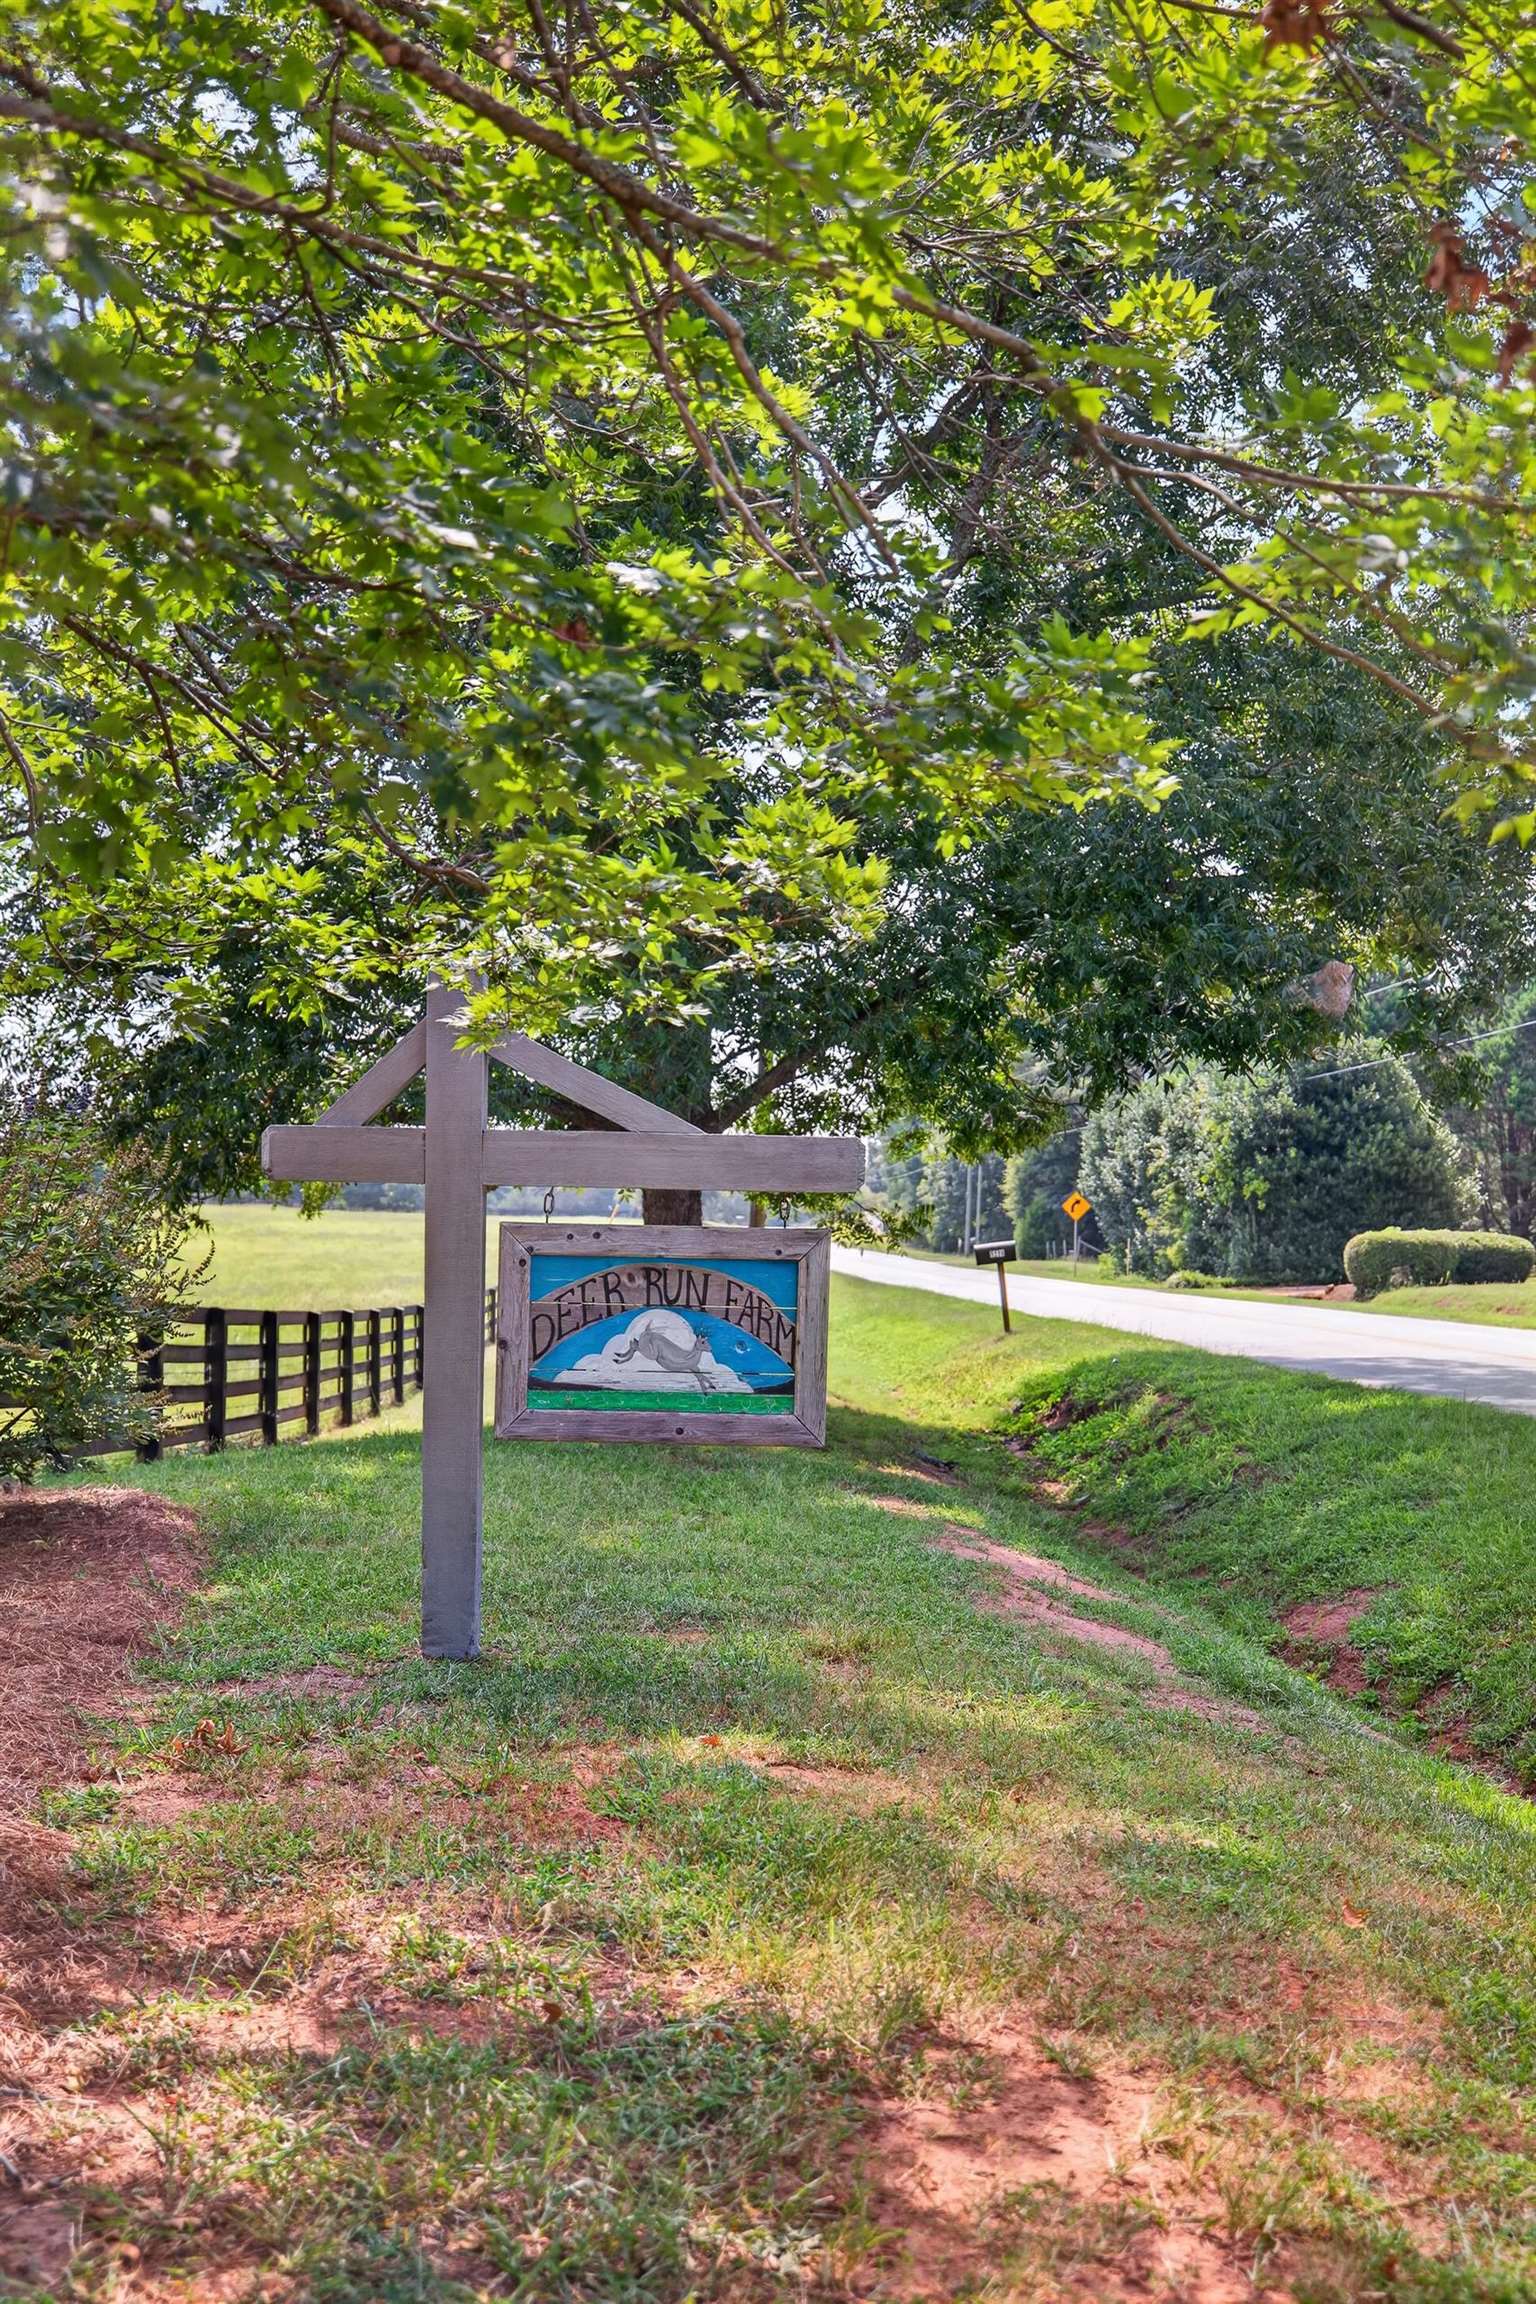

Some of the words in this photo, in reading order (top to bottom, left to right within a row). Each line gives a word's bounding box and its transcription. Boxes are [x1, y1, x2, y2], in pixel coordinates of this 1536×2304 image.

[532, 1271, 625, 1361] DEER
[640, 1267, 711, 1312] RUN
[722, 1280, 796, 1369] FARM
